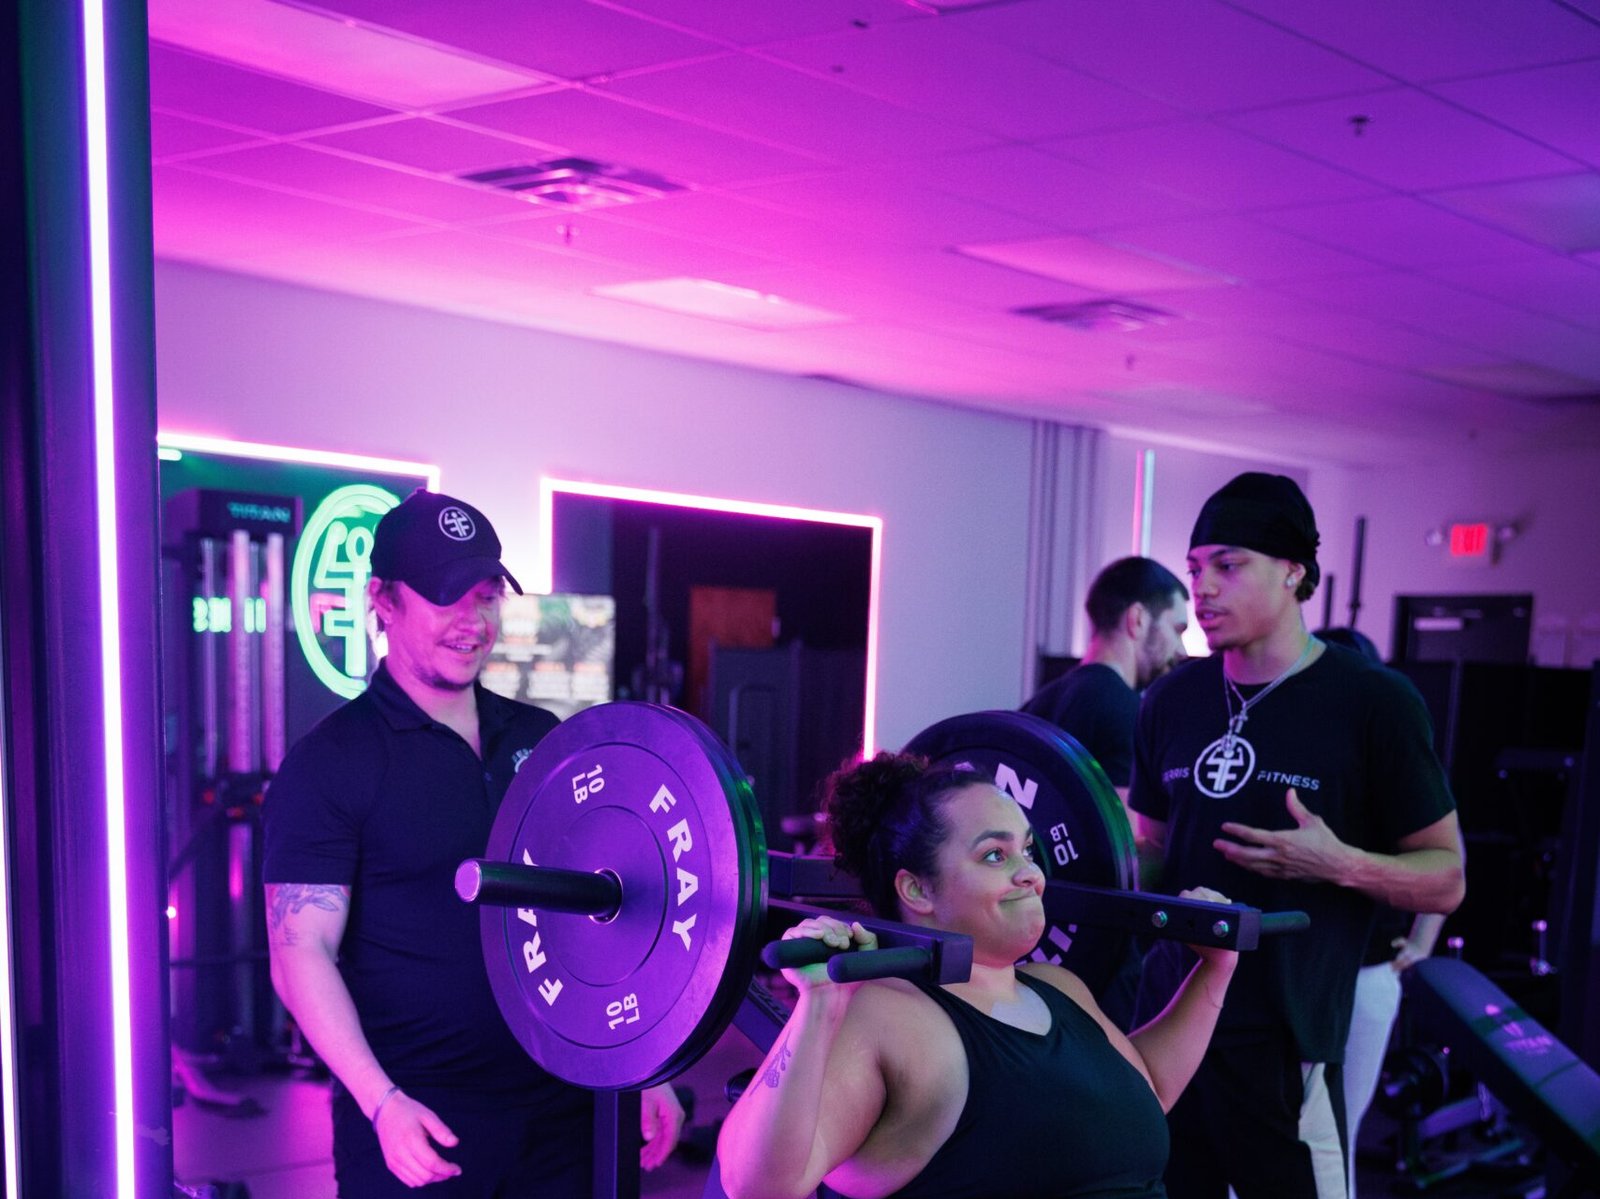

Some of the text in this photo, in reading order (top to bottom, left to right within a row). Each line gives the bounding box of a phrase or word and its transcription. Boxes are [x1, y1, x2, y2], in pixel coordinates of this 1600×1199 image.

[572, 772, 589, 804] LB
[587, 764, 605, 794] 10
[1257, 770, 1321, 791] FITNESS
[1050, 822, 1069, 842] LB
[649, 784, 699, 952] FRAY
[1054, 840, 1079, 867] 10
[606, 1001, 625, 1031] 10
[623, 993, 641, 1025] LB
